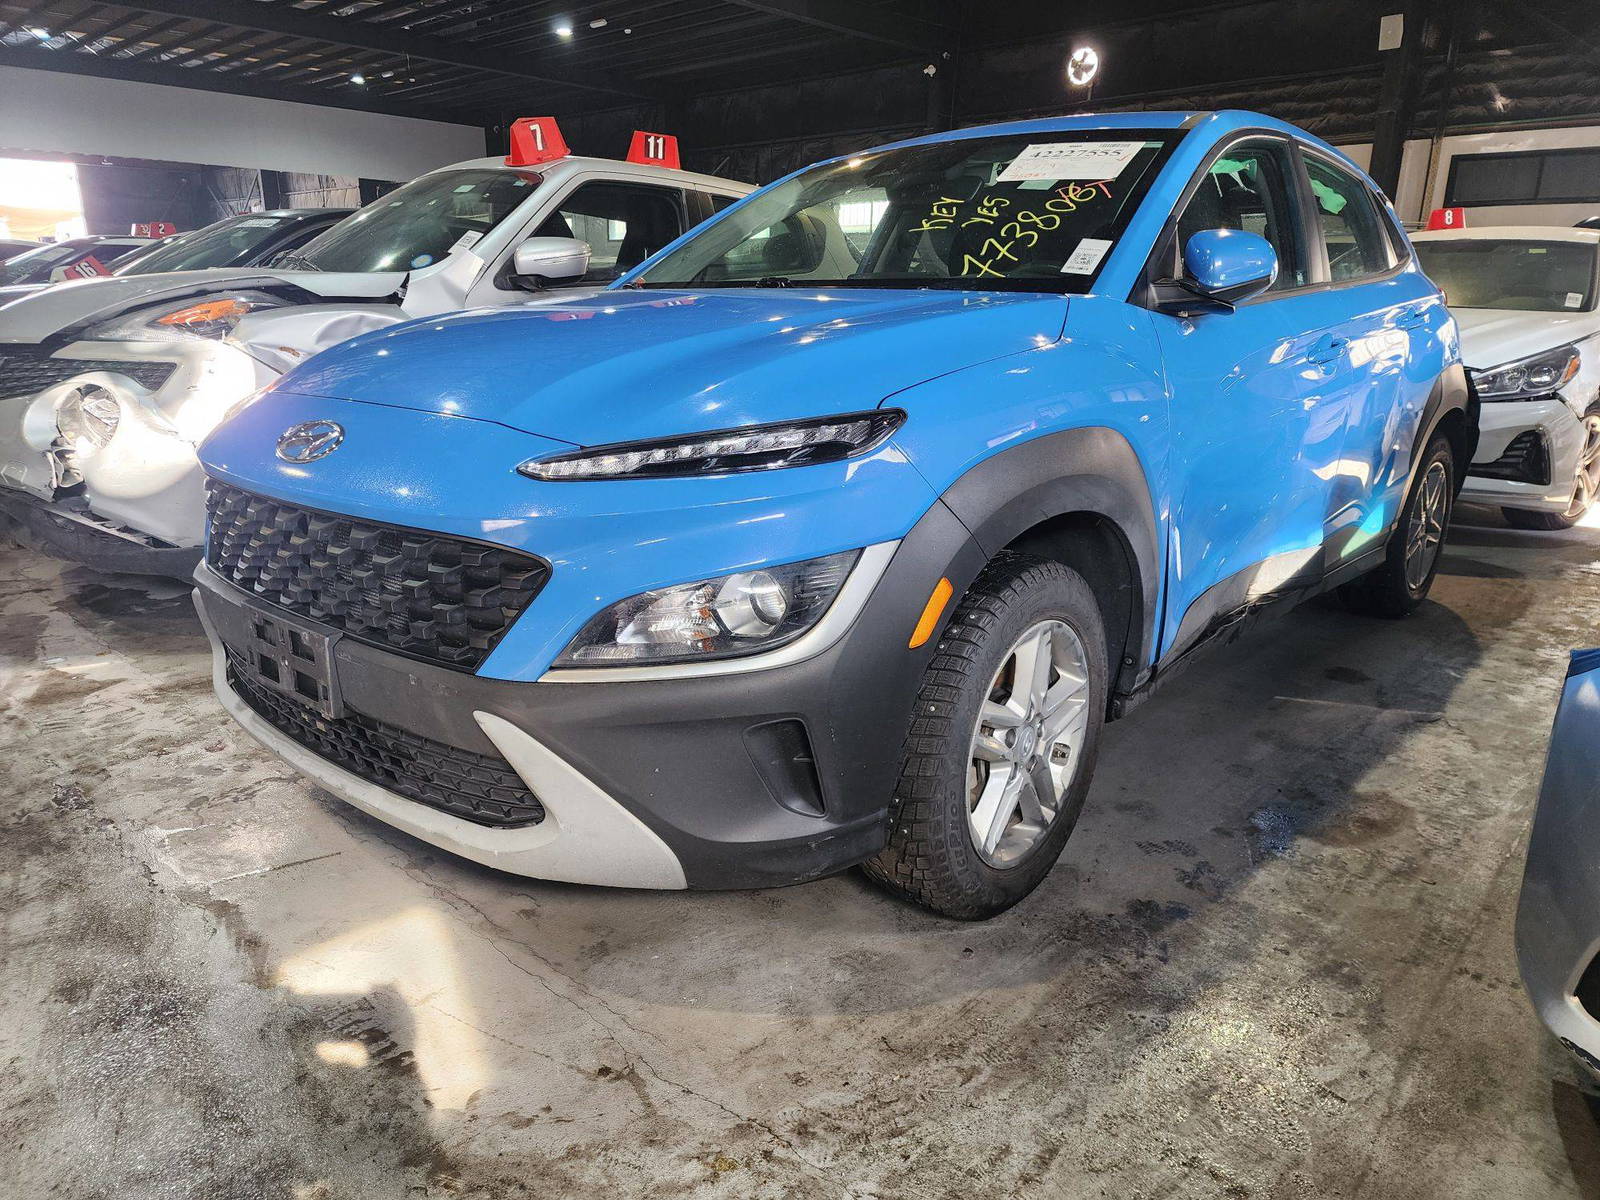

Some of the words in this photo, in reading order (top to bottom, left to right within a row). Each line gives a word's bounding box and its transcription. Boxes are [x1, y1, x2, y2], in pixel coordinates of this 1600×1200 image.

[530, 124, 542, 151] 7
[647, 136, 664, 159] 11
[961, 195, 1010, 227] YES
[1445, 209, 1453, 225] 8
[158, 223, 165, 234] 2
[74, 261, 98, 279] 16
